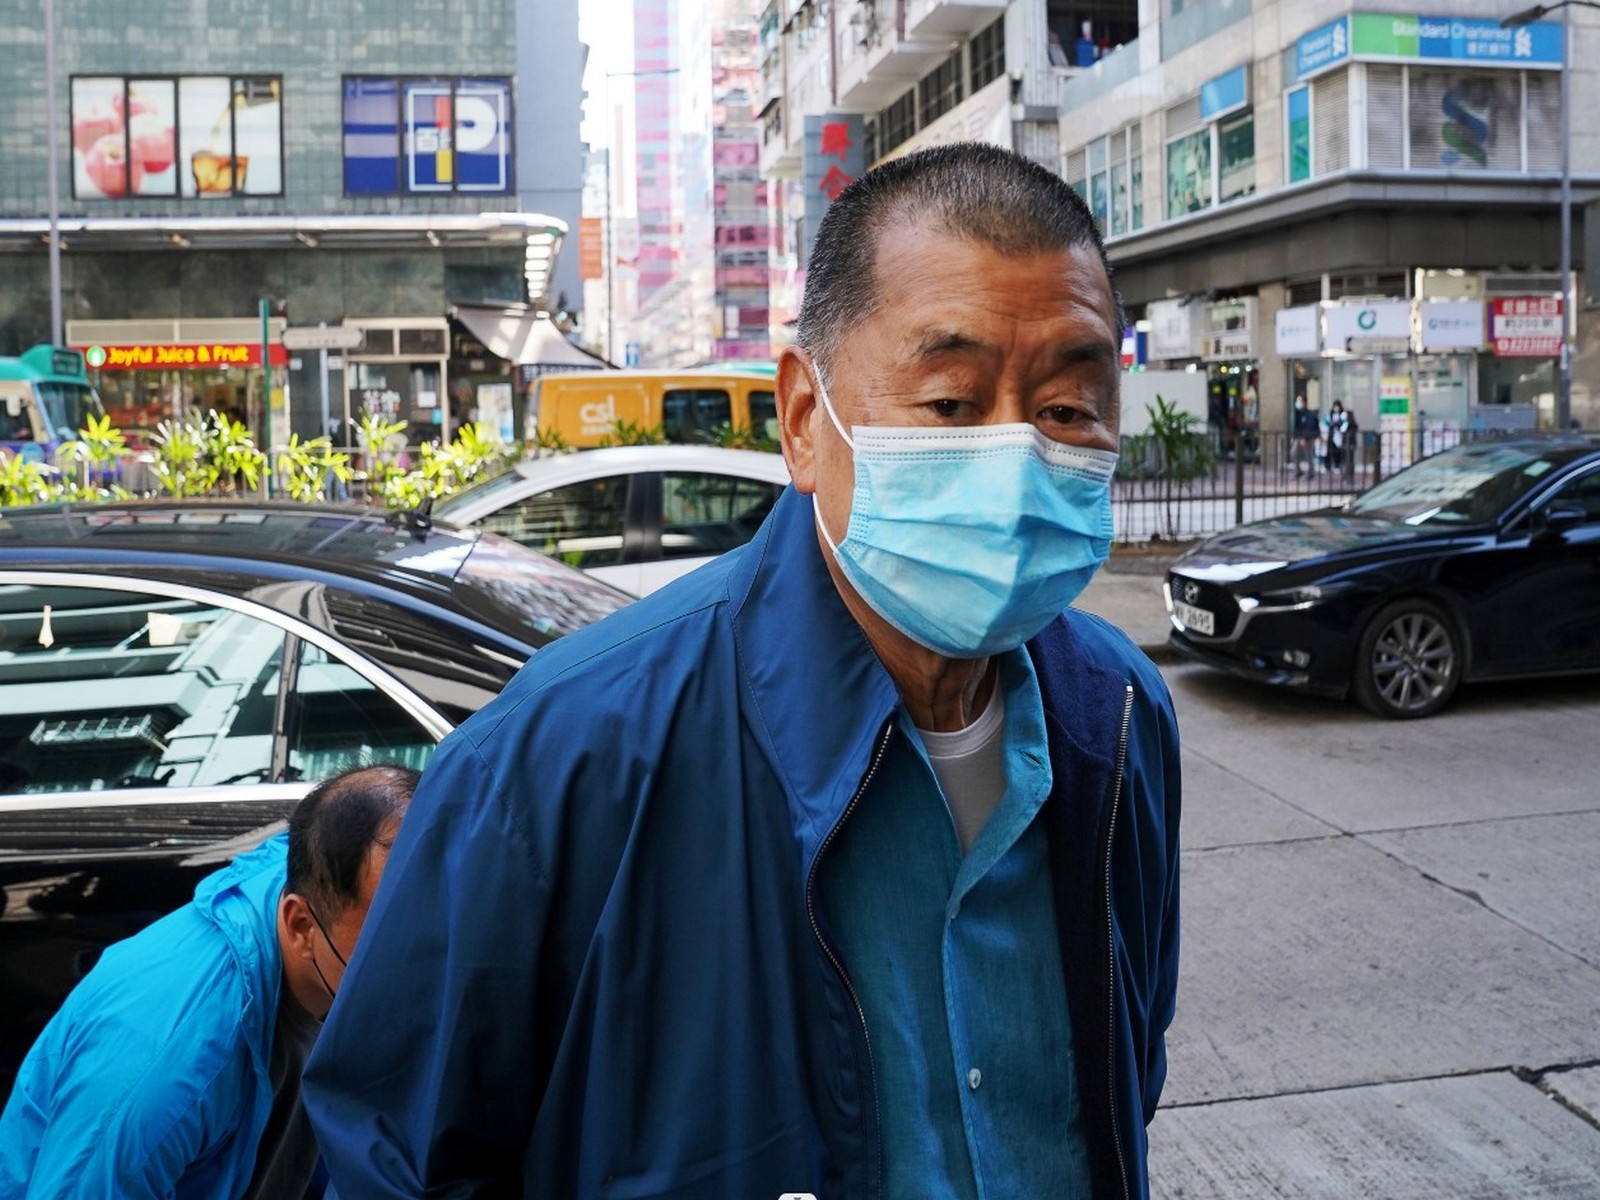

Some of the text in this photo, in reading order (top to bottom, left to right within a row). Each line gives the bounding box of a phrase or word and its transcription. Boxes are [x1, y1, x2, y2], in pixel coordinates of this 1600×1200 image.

[1393, 20, 1511, 41] Standard Chartered
[108, 346, 248, 366] Joyful Juice & Fruit
[579, 393, 616, 423] csl
